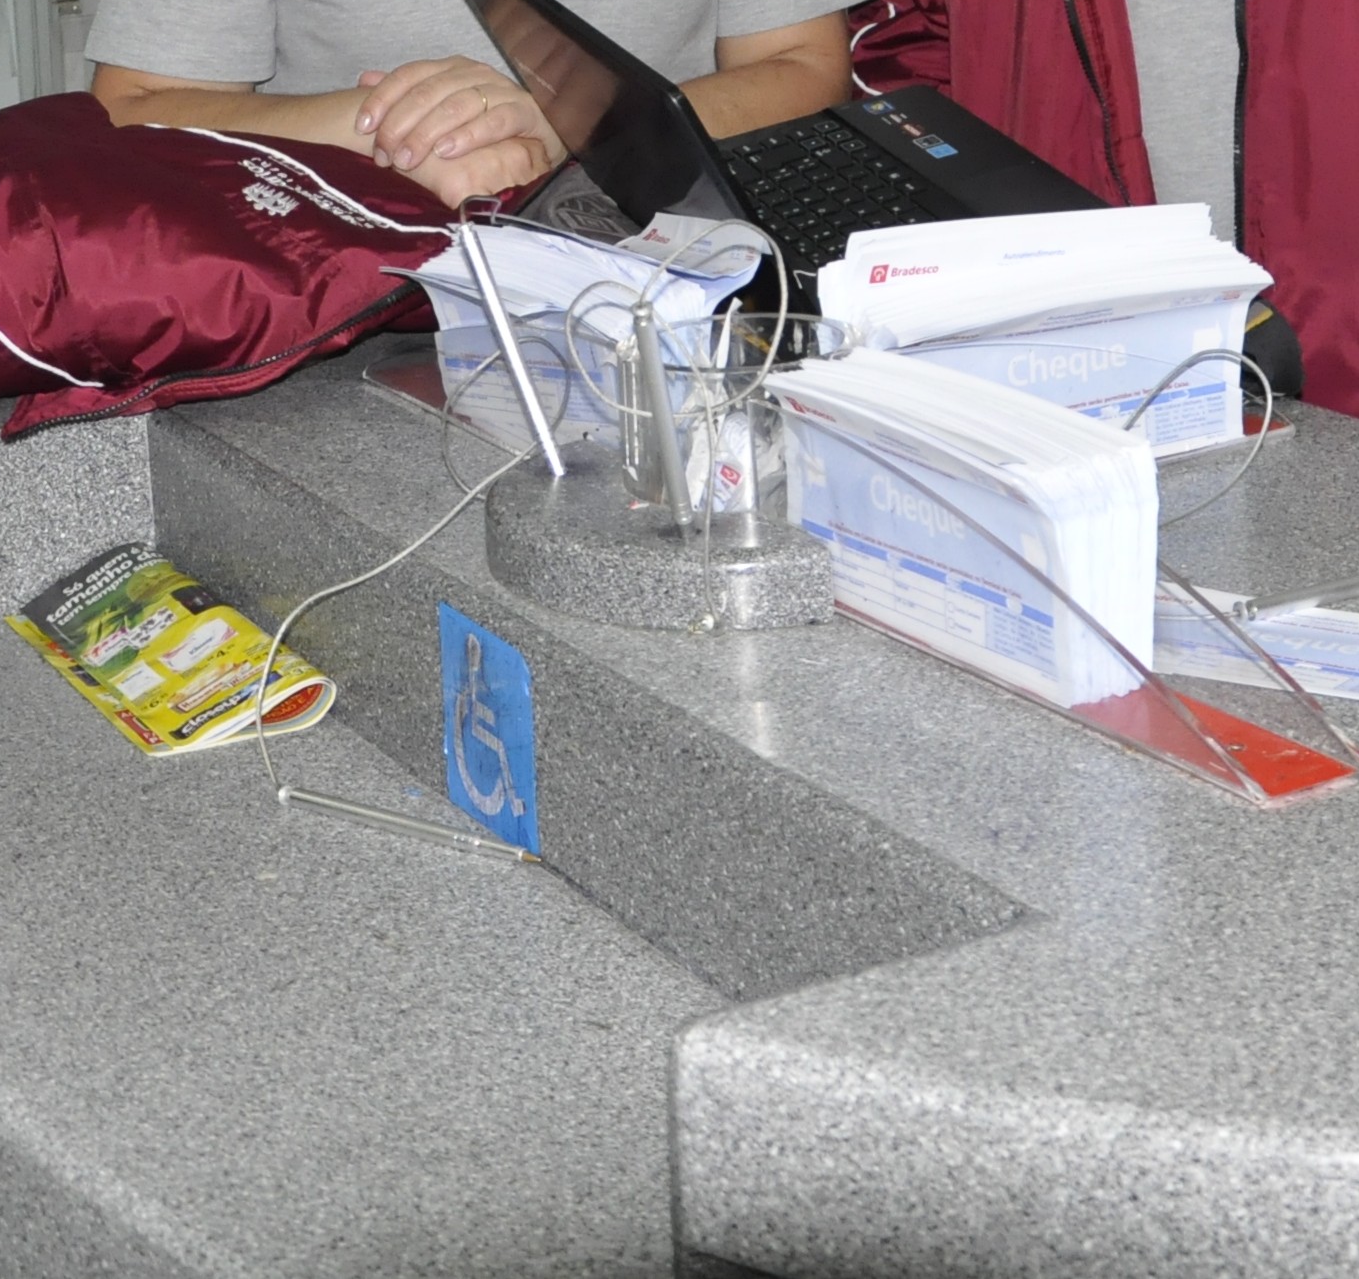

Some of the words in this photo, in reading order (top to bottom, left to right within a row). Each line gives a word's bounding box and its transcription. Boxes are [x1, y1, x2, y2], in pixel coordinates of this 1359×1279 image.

[891, 265, 939, 277] Bradesco
[1007, 341, 1128, 388] Cheque
[869, 474, 965, 540] Cheque
[46, 560, 133, 623] tamanho
[63, 582, 83, 596] Só
[85, 552, 128, 583] quem
[58, 605, 84, 626] tem
[85, 571, 132, 605] sempre
[181, 695, 240, 734] closeup
